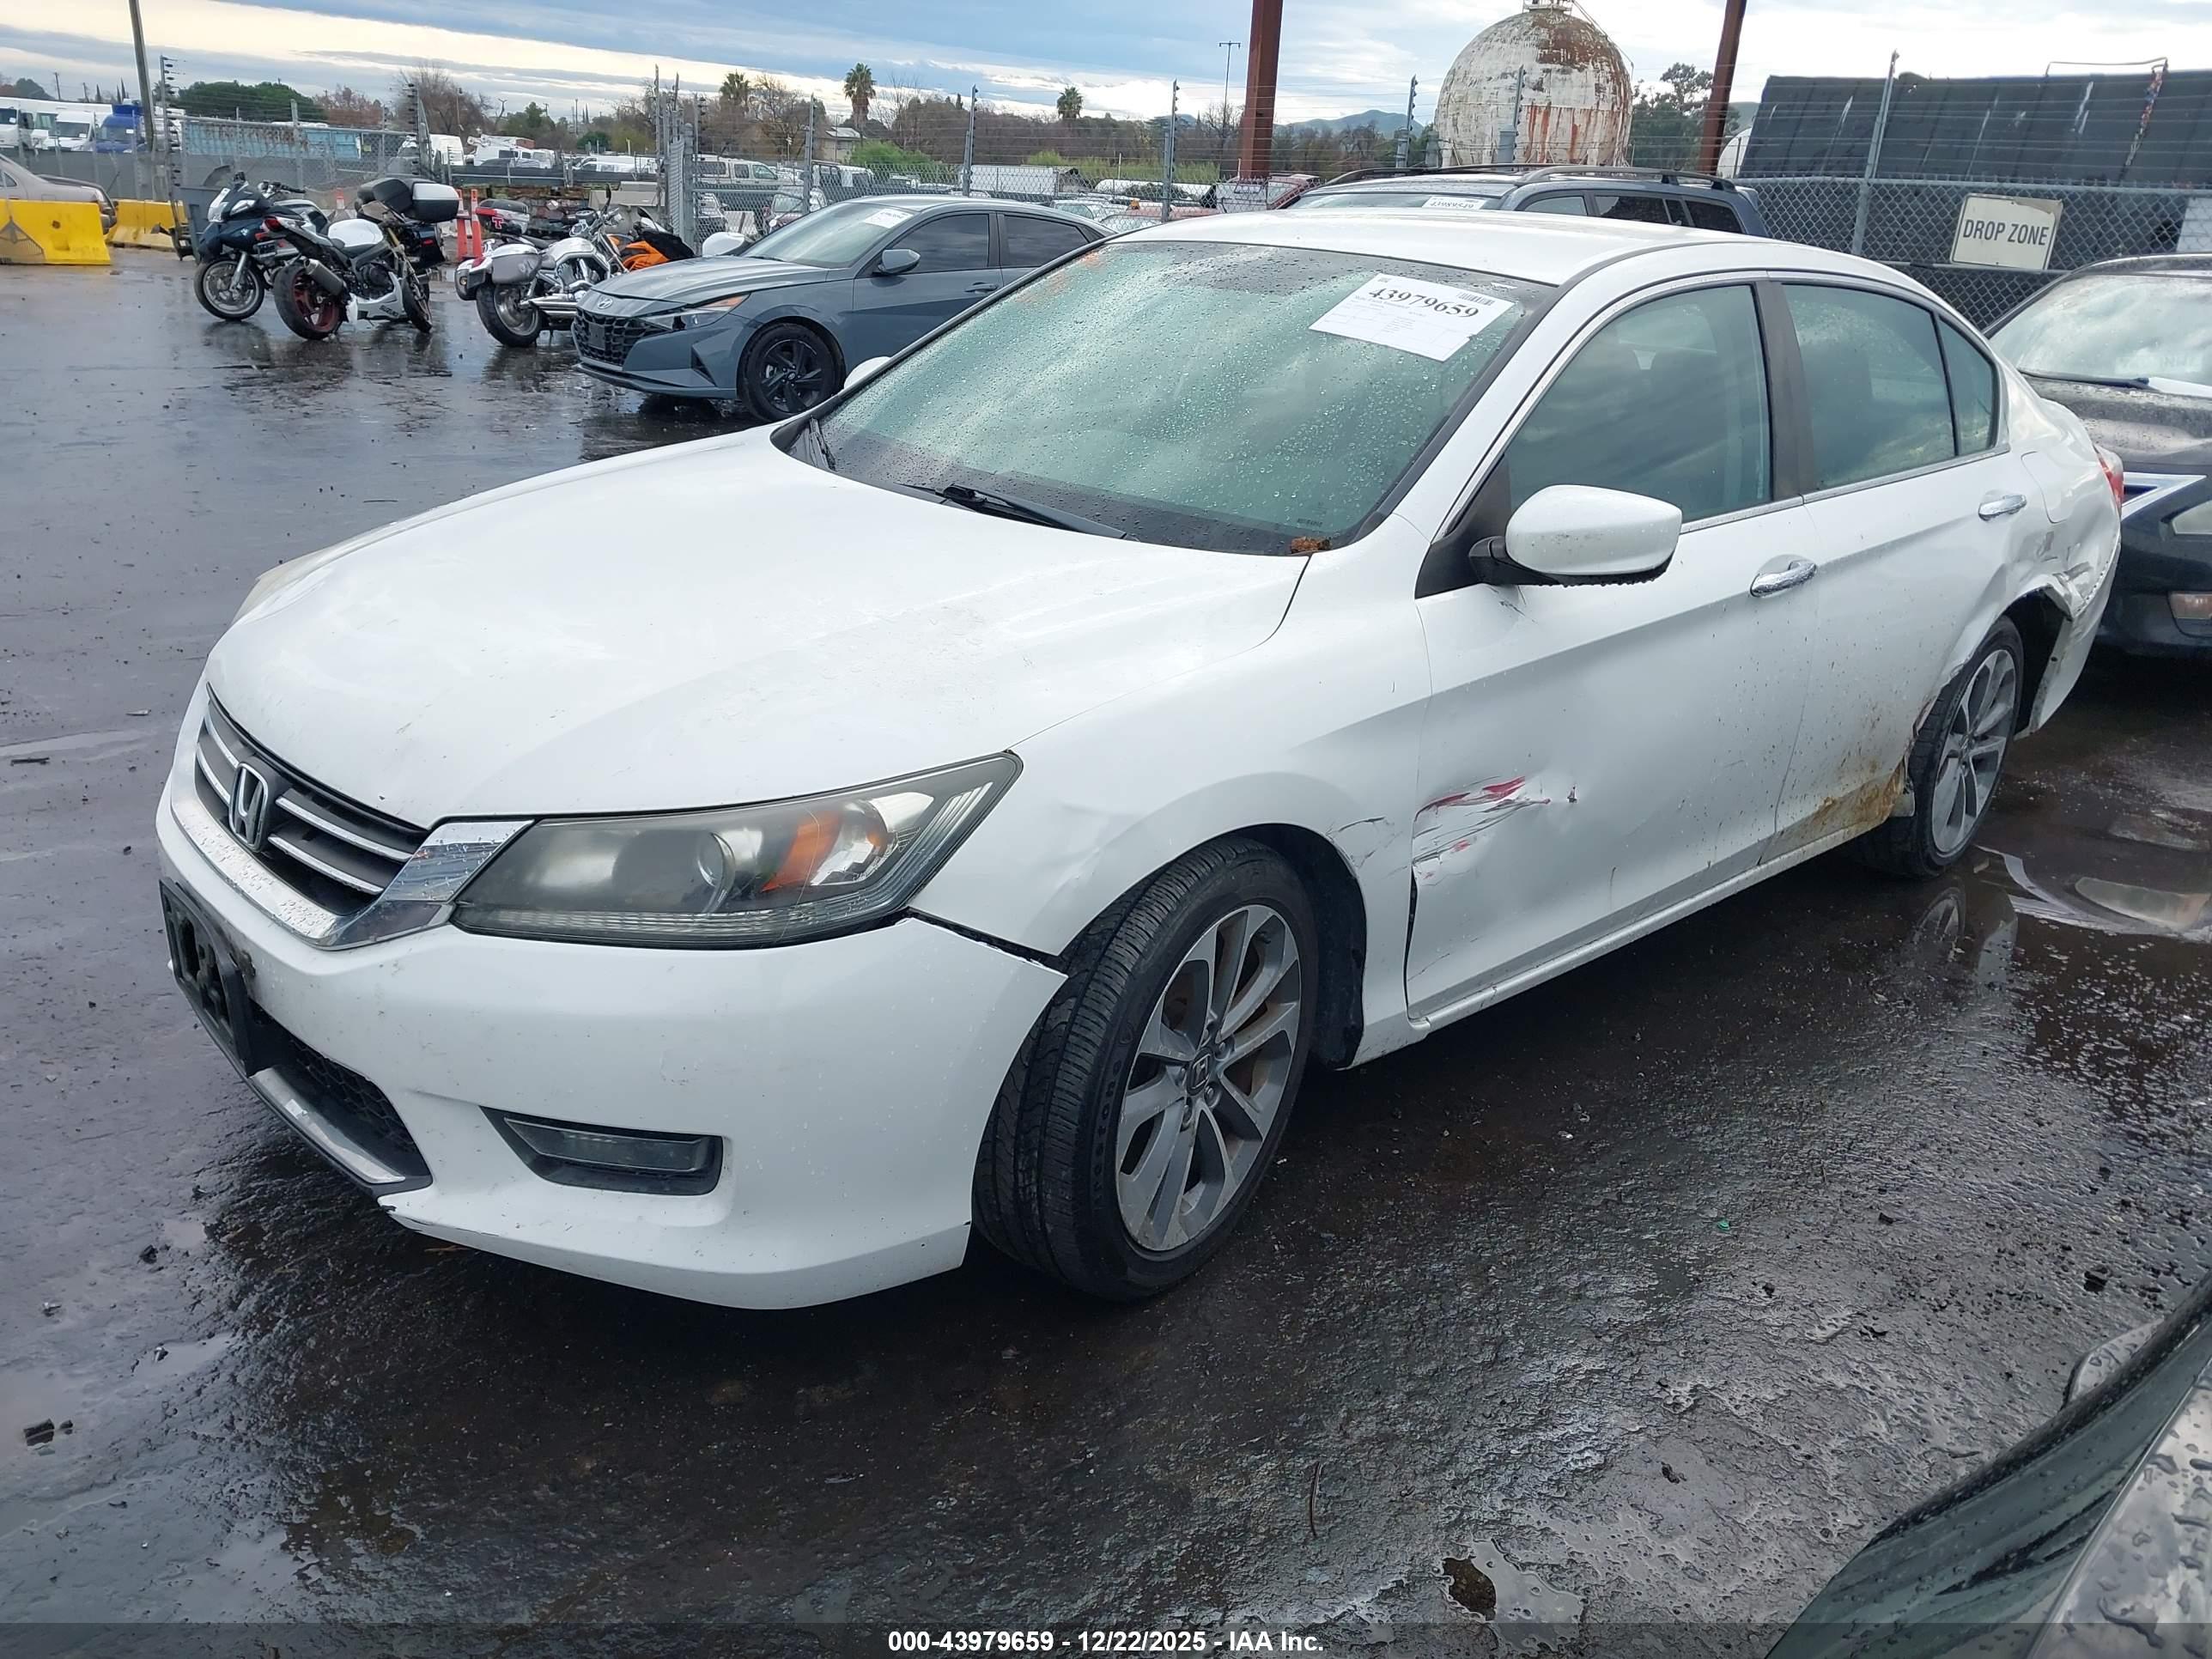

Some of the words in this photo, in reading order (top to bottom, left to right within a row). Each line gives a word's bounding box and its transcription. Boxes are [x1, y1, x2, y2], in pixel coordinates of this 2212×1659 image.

[1963, 219, 2006, 240] DROP
[2008, 223, 2050, 246] ZONE
[1368, 287, 1480, 318] 43979659
